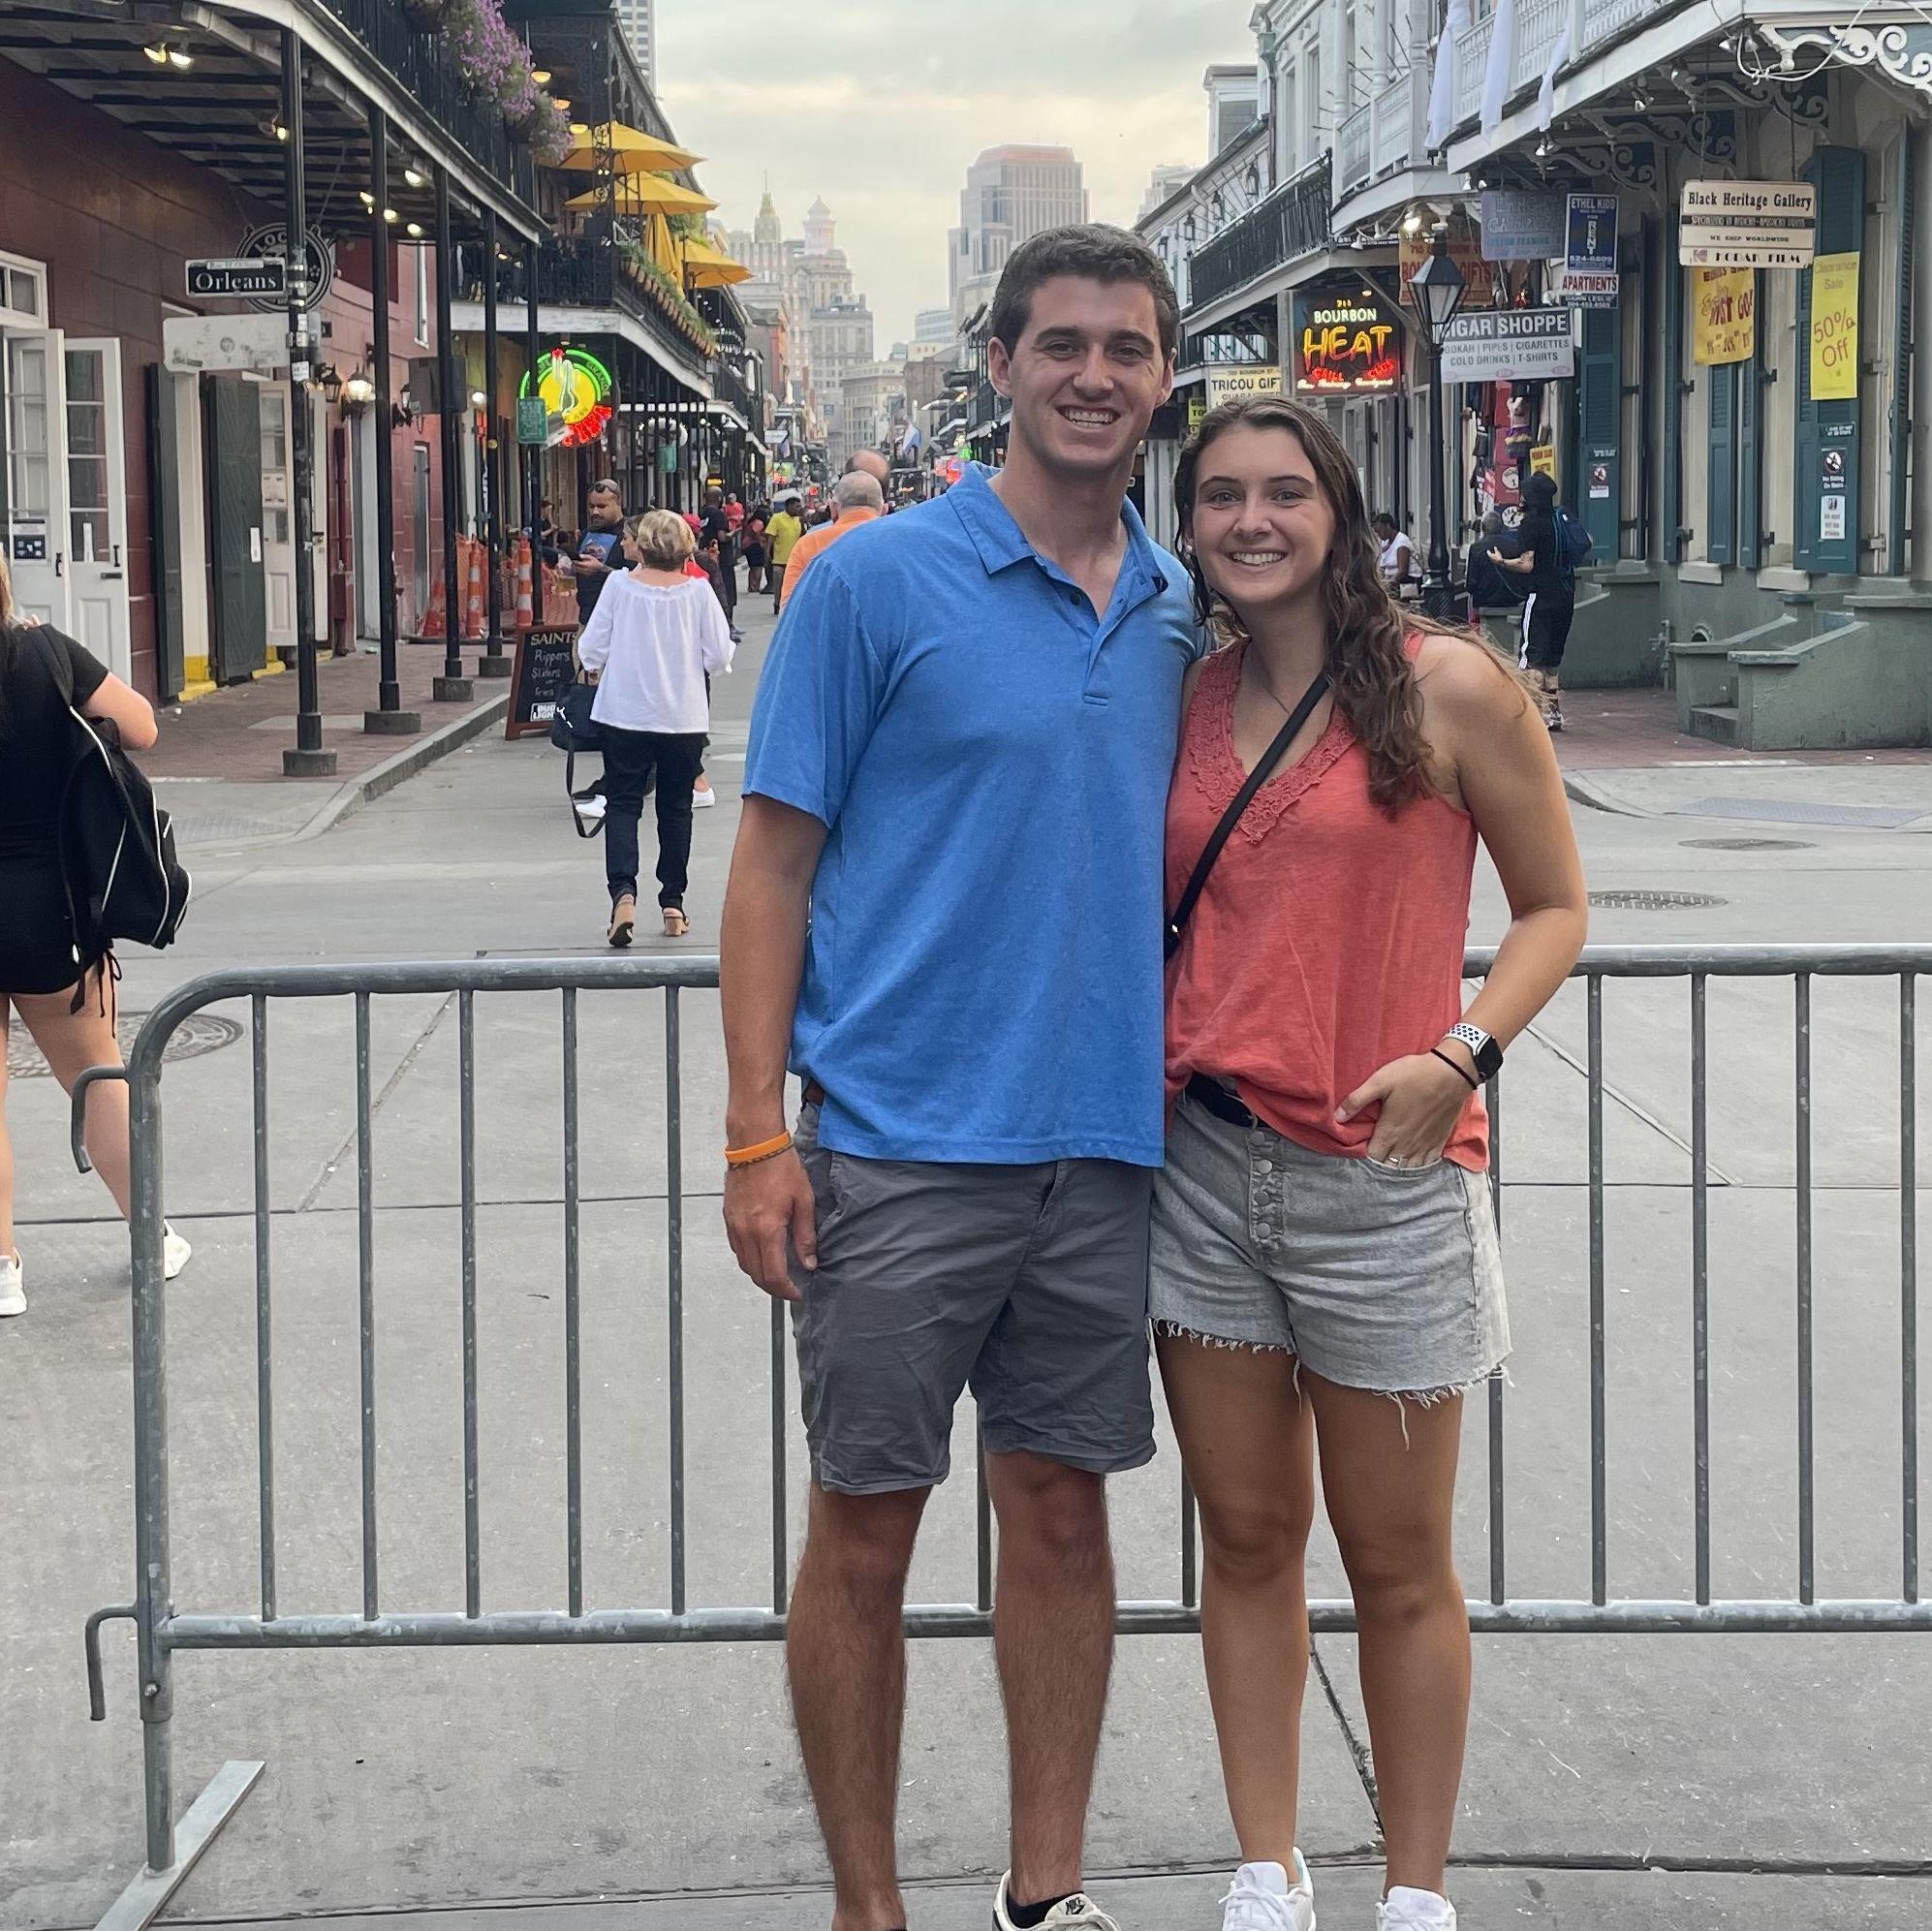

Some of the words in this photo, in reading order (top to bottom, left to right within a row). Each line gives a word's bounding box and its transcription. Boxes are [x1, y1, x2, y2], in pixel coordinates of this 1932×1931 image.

[1571, 198, 1596, 209] ETHEL
[1688, 191, 1717, 205] Black
[1723, 192, 1767, 210] Heritage
[1773, 193, 1812, 211] Gallery
[1586, 220, 1597, 255] RENT
[1715, 252, 1761, 263] KODAK
[1768, 254, 1801, 264] FILM
[1814, 261, 1857, 274] Clearance
[195, 271, 277, 291] Orleans
[1562, 276, 1617, 292] APARTMENTS
[1823, 278, 1844, 291] Sale
[1313, 308, 1378, 325] BOURBON
[1498, 314, 1567, 335] SHOPPE
[1813, 307, 1856, 344] 50%
[1303, 325, 1393, 373] HEAT
[1444, 342, 1474, 355] OOKAH
[1482, 342, 1509, 352] PIPES
[1515, 338, 1570, 351] CIGARETTES
[1822, 336, 1850, 368] Off
[1450, 356, 1474, 366] COLD
[1477, 354, 1511, 365] DRINKS
[1517, 352, 1559, 362] T-SHIRTS
[1210, 378, 1255, 391] TRICOU
[531, 667, 562, 679] Sliders
[532, 711, 555, 720] LIGH
[537, 704, 556, 713] BUD
